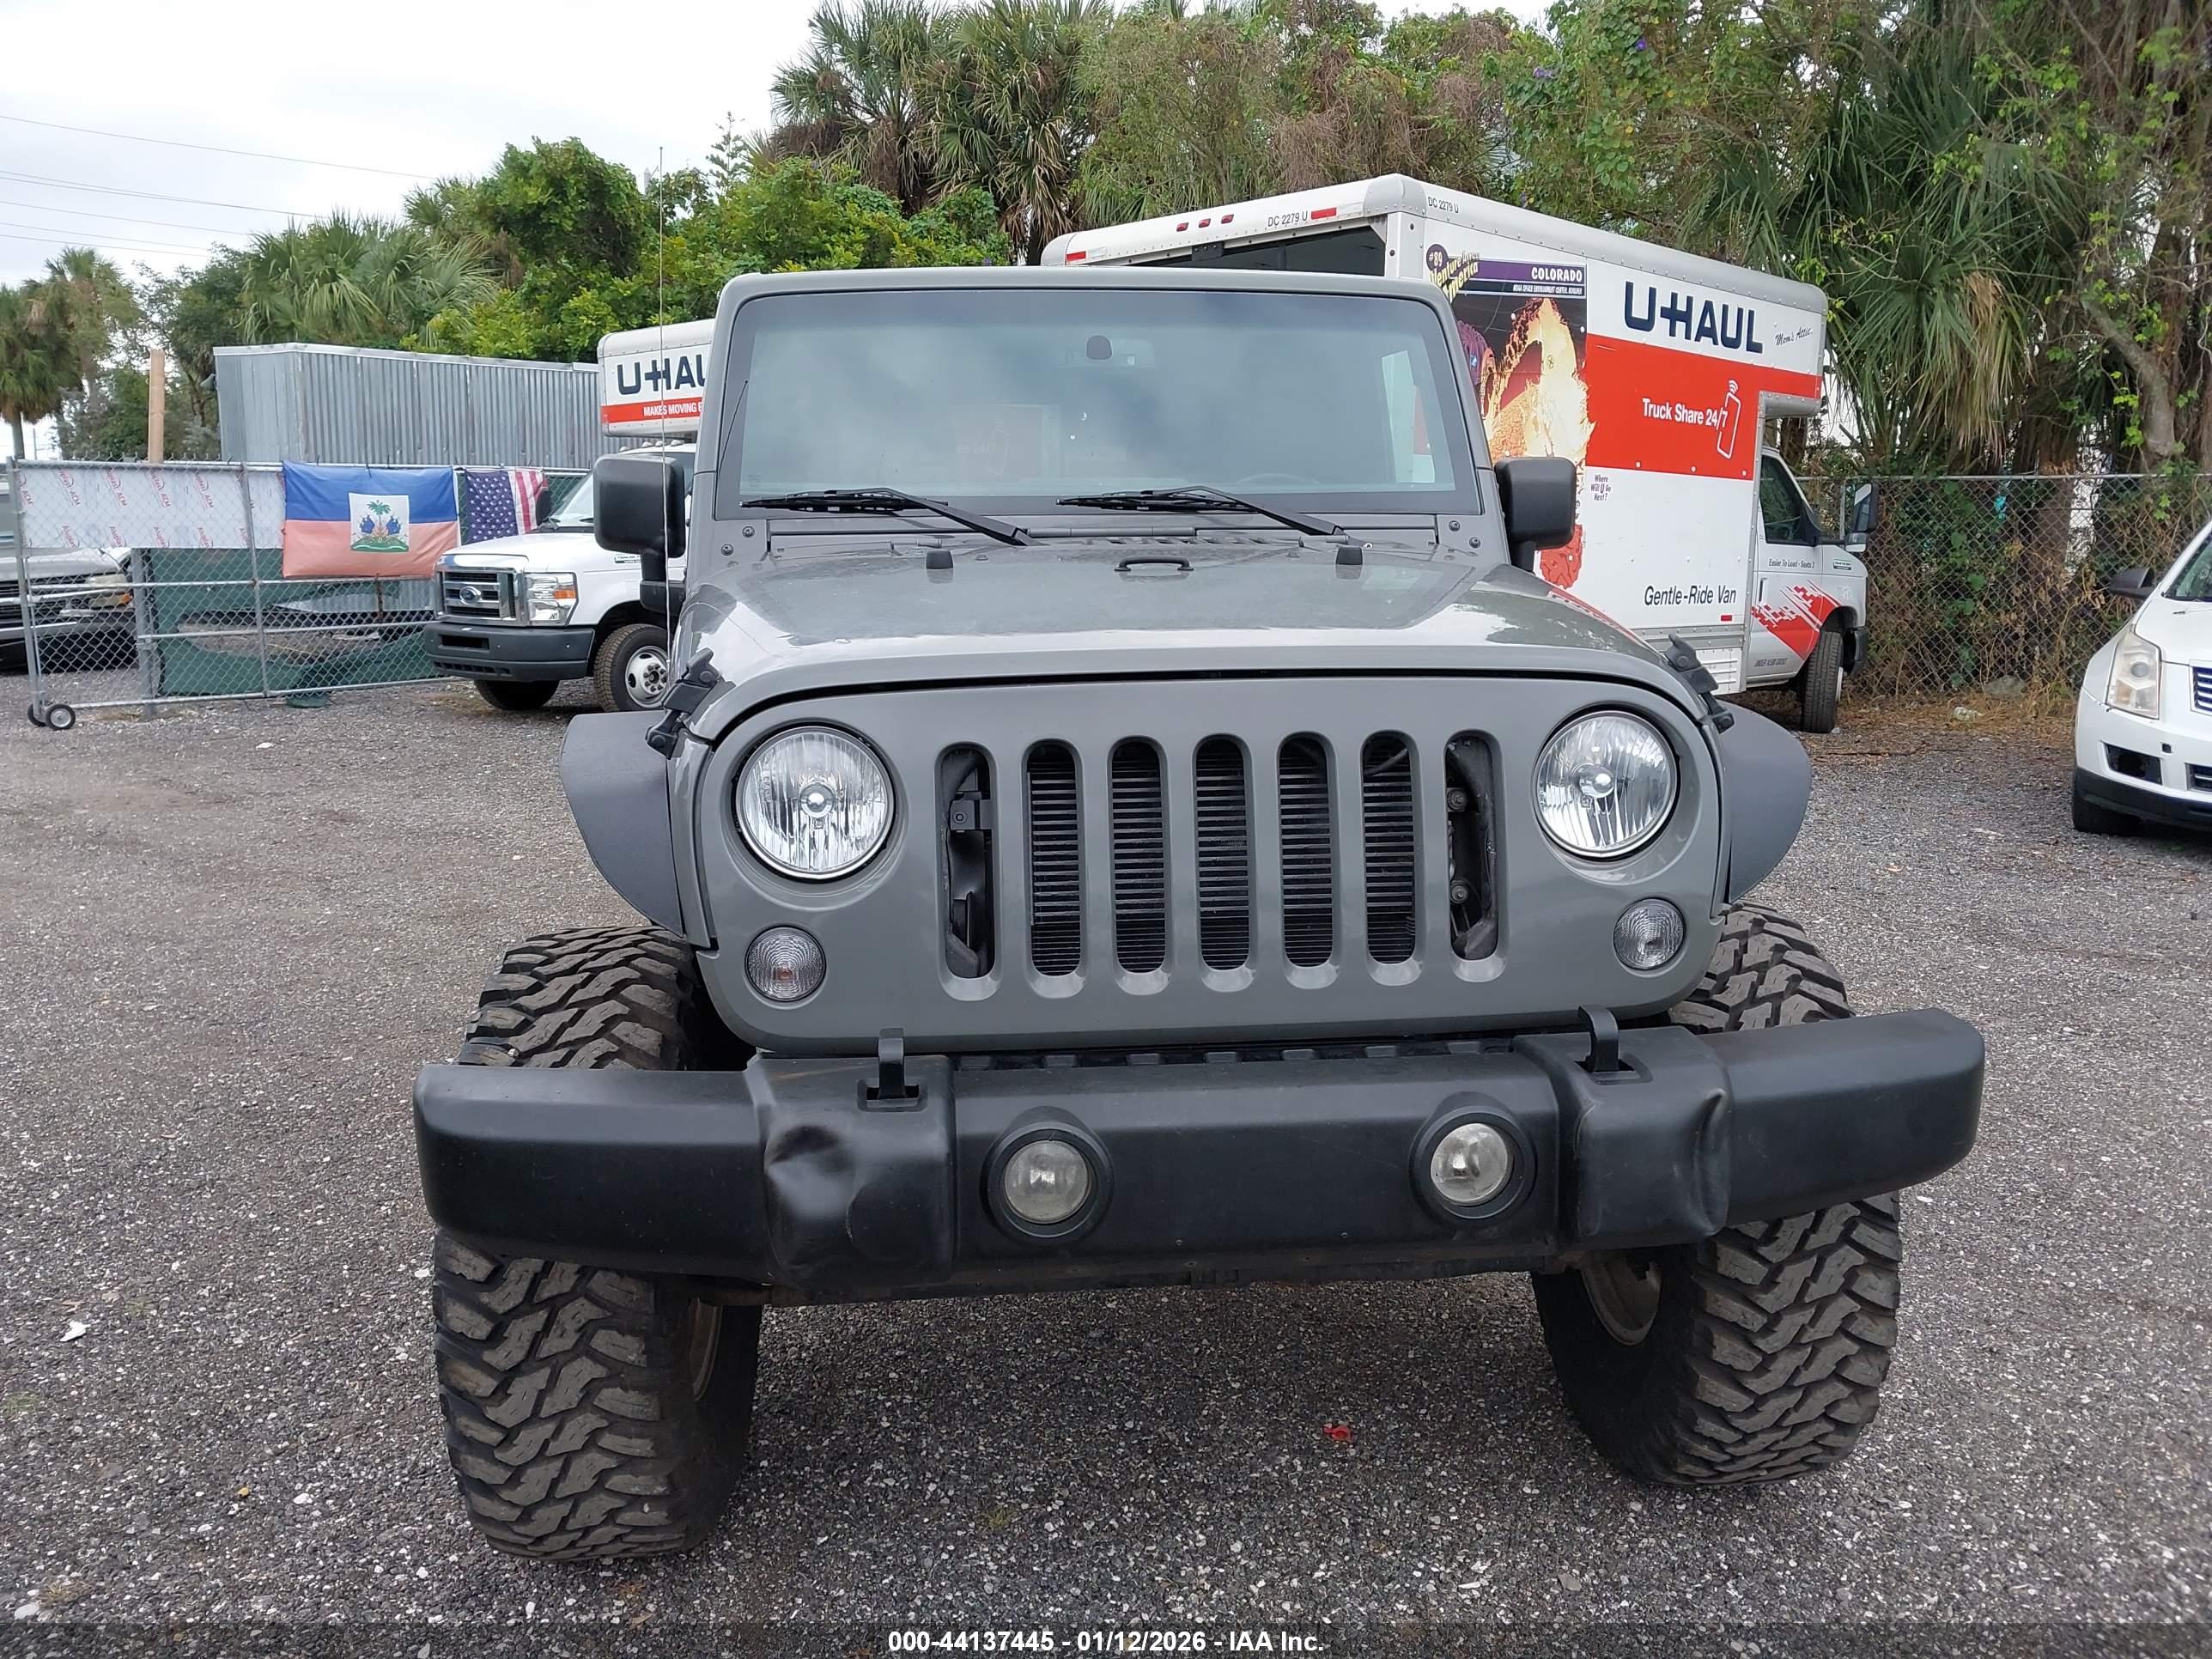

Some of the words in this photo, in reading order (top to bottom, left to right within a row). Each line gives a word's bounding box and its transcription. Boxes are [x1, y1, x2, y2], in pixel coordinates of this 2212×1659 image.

[1428, 197, 1437, 208] DC
[1438, 199, 1453, 212] 2279
[1454, 203, 1459, 213] U
[1267, 216, 1279, 227] DC
[1281, 212, 1299, 225] 2279
[1302, 210, 1308, 221] U
[1428, 251, 1443, 267] #89
[1531, 266, 1583, 282] COLORADO
[643, 404, 667, 416] MAKES
[668, 402, 696, 415] MOVING
[1642, 398, 1673, 420] Truck
[1674, 403, 1705, 425] Share
[1705, 406, 1728, 431] 24/7
[69, 490, 81, 506] ACM
[1644, 585, 1714, 606] Gentle-Ride
[1718, 585, 1736, 604] Van
